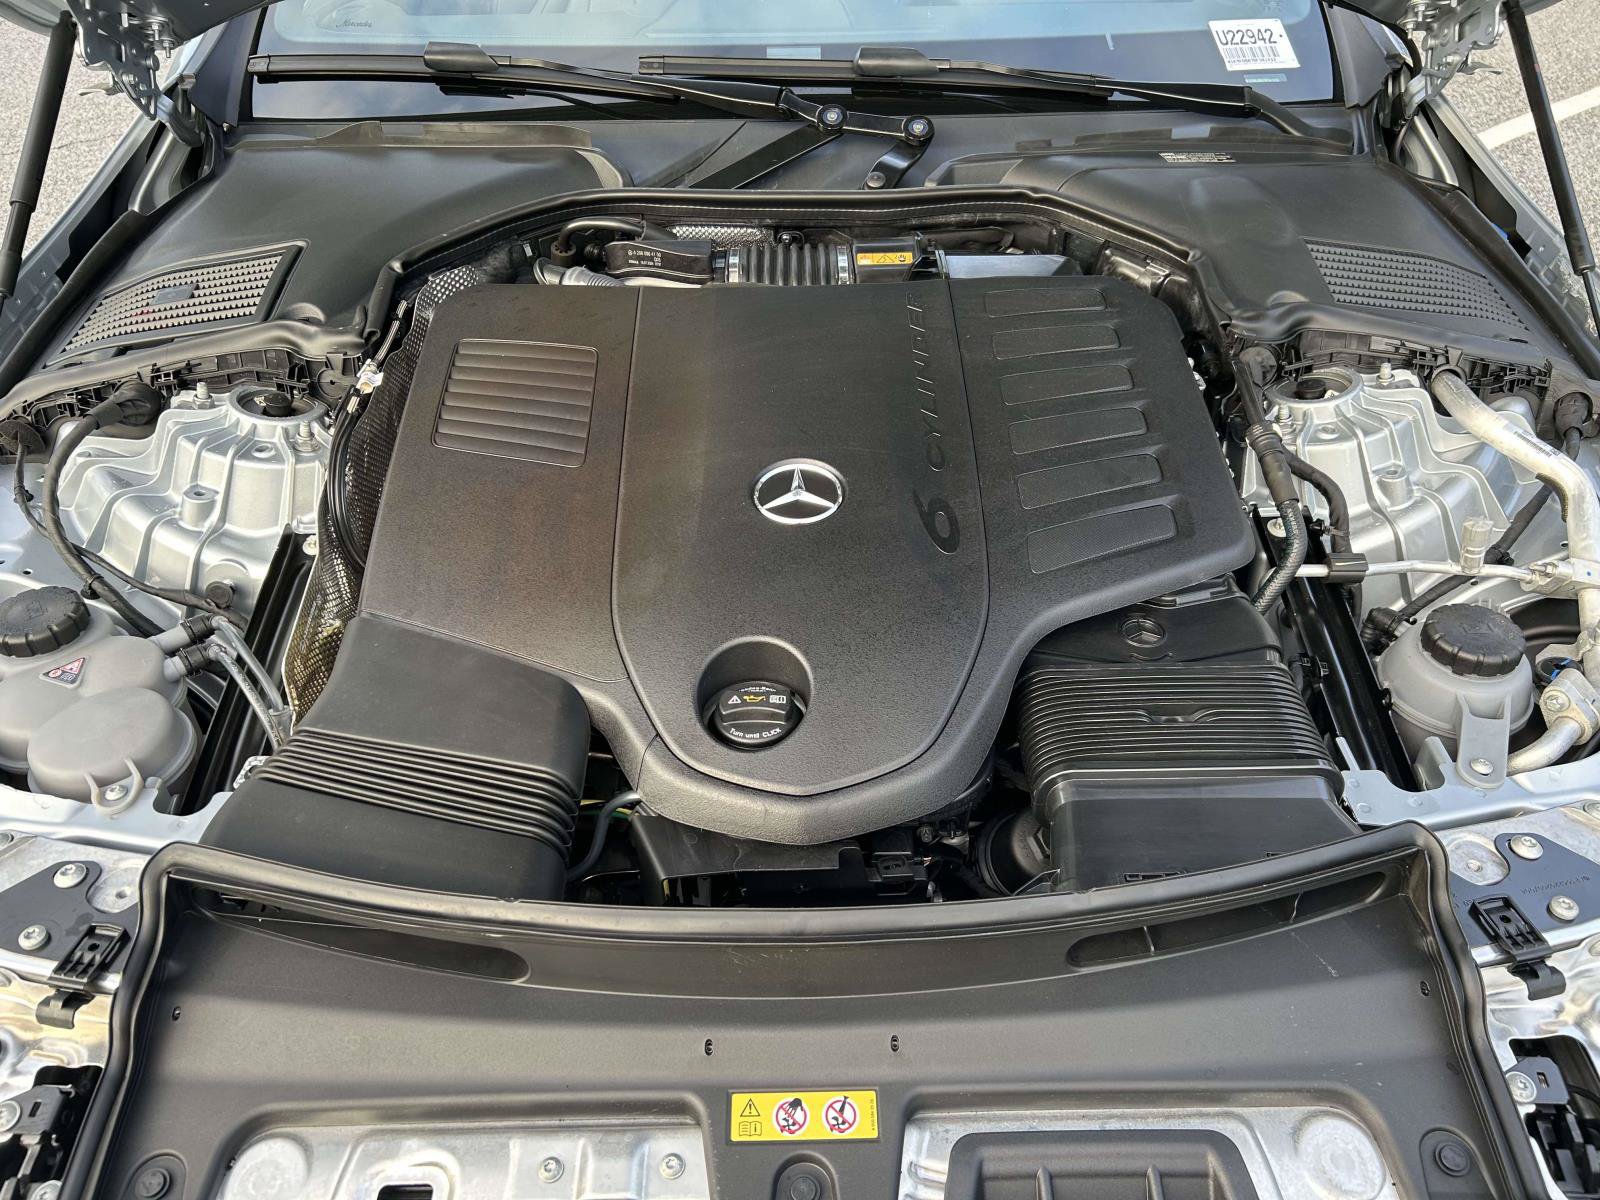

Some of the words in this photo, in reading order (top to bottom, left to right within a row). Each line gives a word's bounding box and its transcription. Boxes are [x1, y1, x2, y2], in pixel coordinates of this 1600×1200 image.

[912, 487, 961, 555] 6
[730, 728, 744, 737] Turn
[762, 728, 782, 737] CLICK
